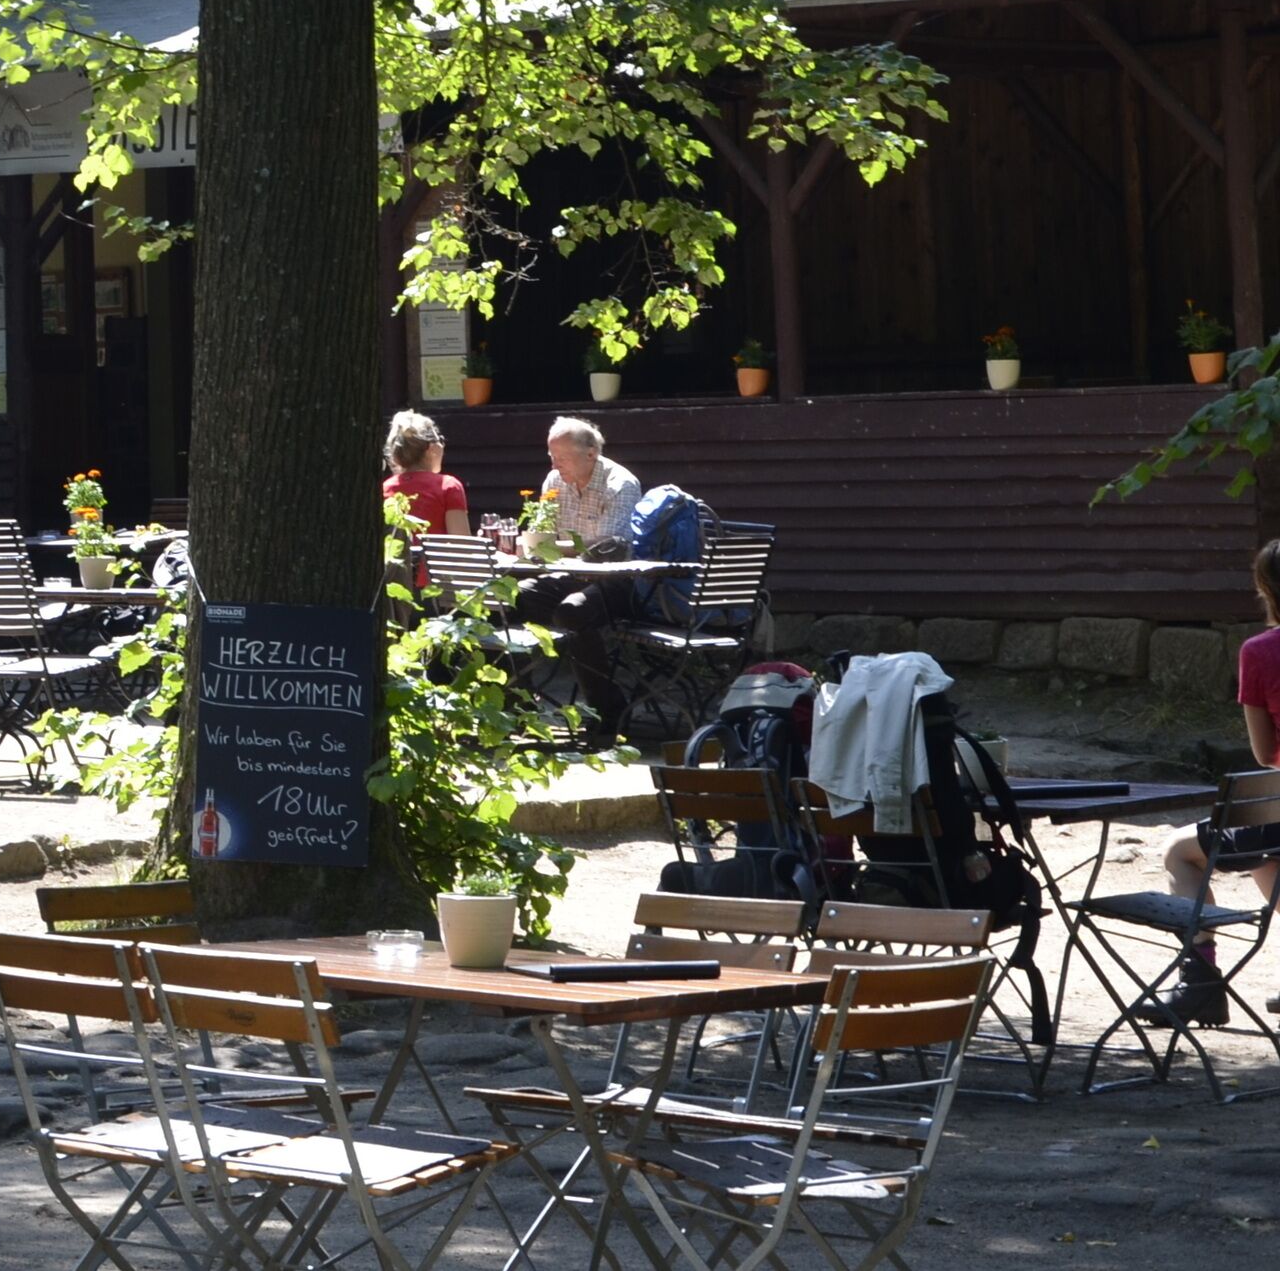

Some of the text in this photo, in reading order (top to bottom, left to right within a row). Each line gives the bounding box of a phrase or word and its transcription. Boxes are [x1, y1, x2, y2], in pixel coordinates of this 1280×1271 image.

[206, 607, 245, 617] BIONADE
[219, 636, 346, 669] HERZLICH
[202, 672, 363, 708] WILLKOMMEN
[204, 723, 347, 756] Wir haben für Sie
[236, 755, 352, 778] bis mindestens
[257, 785, 349, 816] 18 Uhr
